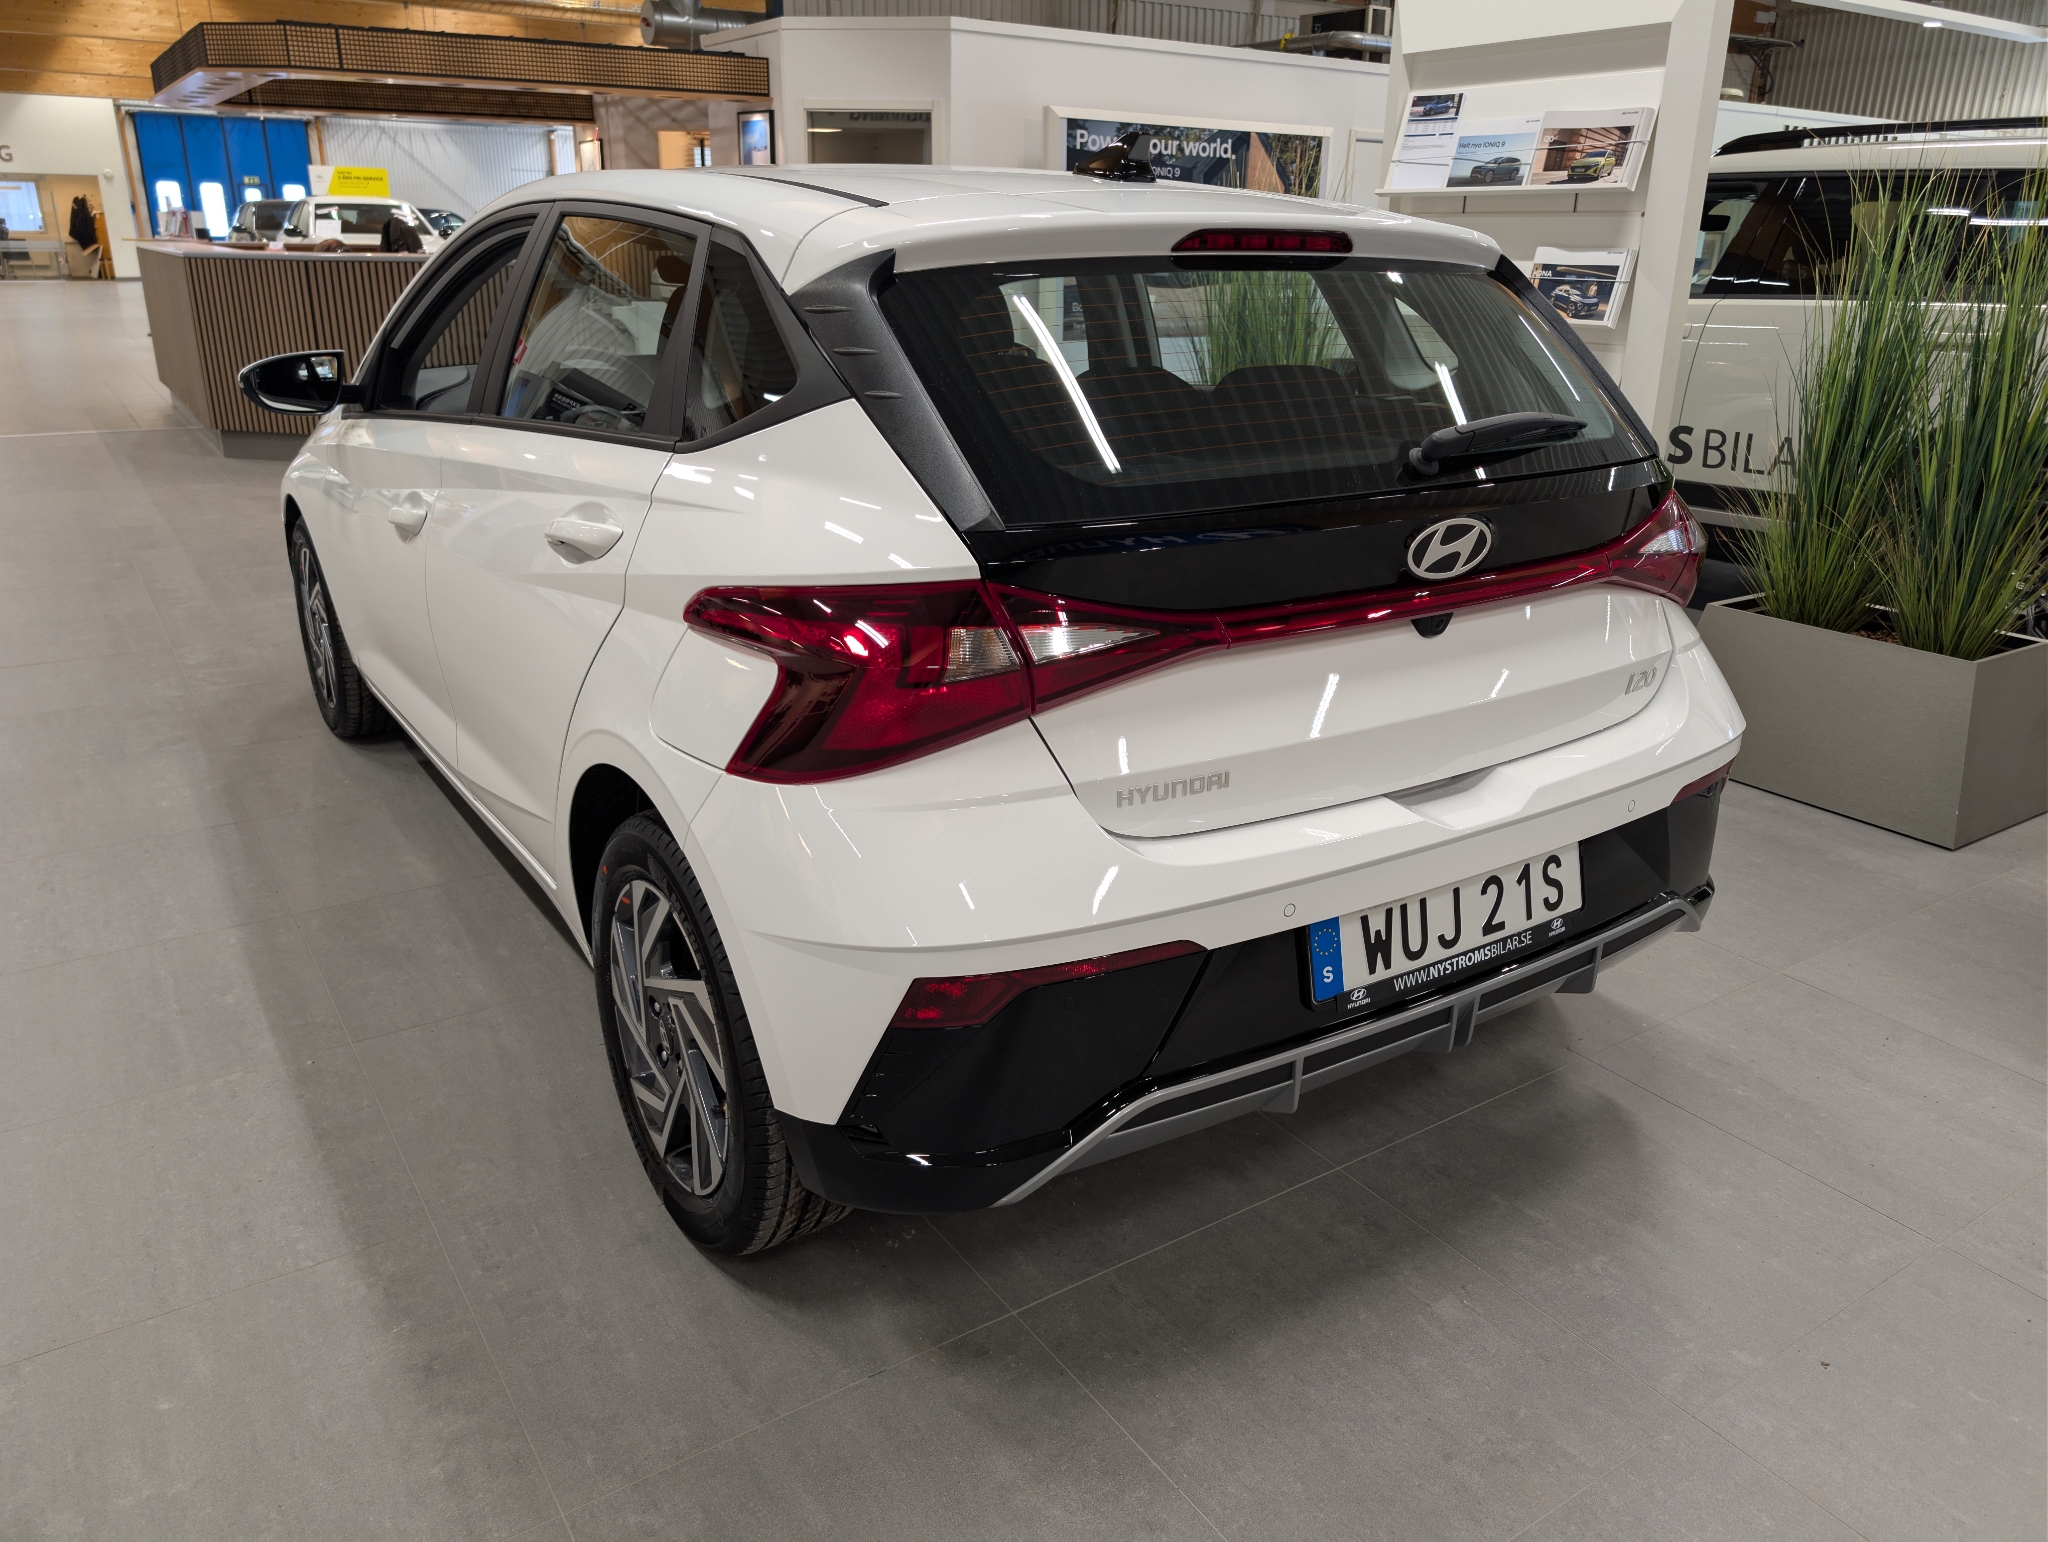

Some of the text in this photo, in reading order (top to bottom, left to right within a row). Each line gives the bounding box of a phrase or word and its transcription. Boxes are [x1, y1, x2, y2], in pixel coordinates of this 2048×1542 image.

[1076, 129, 1118, 151] Pow
[1149, 138, 1179, 155] our
[1458, 141, 1470, 149] Helt
[1482, 141, 1500, 149] IONIQ
[1501, 140, 1506, 148] 9
[1152, 166, 1181, 178] ONIQ 9
[1534, 269, 1552, 277] KONA
[1116, 770, 1231, 808] HYUNDAI
[1359, 854, 1564, 976] WUJ 21S
[1548, 926, 1566, 937] HYUNDAI
[1393, 931, 1533, 992] WWW.NYSTROMSBILAR.SE
[1322, 966, 1334, 983] S
[1347, 997, 1371, 1010] HYUNDAI
